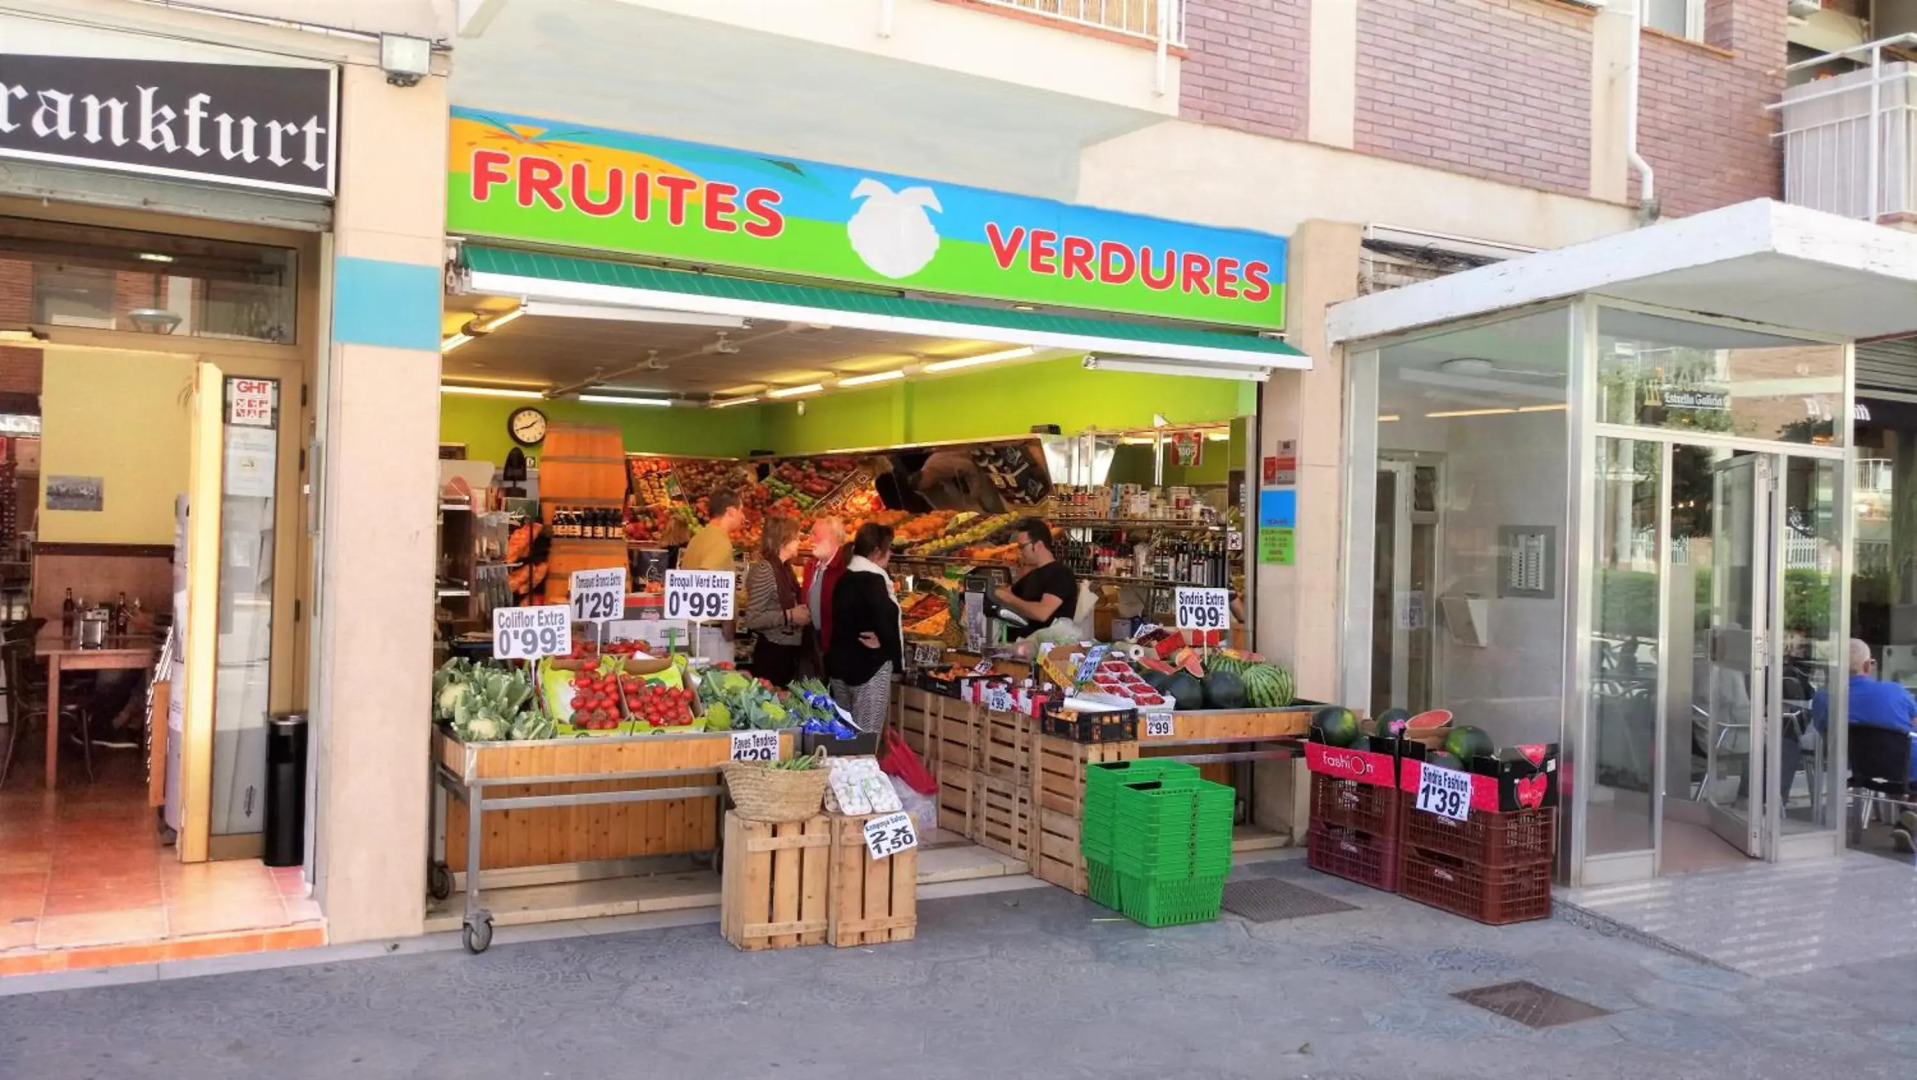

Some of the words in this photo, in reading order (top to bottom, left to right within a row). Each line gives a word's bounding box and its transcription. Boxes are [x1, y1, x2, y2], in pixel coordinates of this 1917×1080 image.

[472, 149, 785, 239] FRUITES
[985, 222, 1271, 302] VERDURES
[236, 381, 268, 394] GHT
[694, 574, 710, 588] Verd
[712, 574, 729, 589] Extra
[575, 591, 614, 619] 1'29
[669, 591, 721, 617] 0'99
[1205, 592, 1225, 606] Extra
[498, 611, 535, 629] Coliflor
[537, 609, 565, 627] Extra
[1180, 605, 1220, 627] 0'99
[499, 627, 557, 656] 0'99
[752, 733, 778, 748] Tendres
[1443, 771, 1468, 793] Fashion
[1421, 783, 1461, 816] 1'39
[870, 830, 889, 845] 2
[872, 833, 914, 854] 1,50
